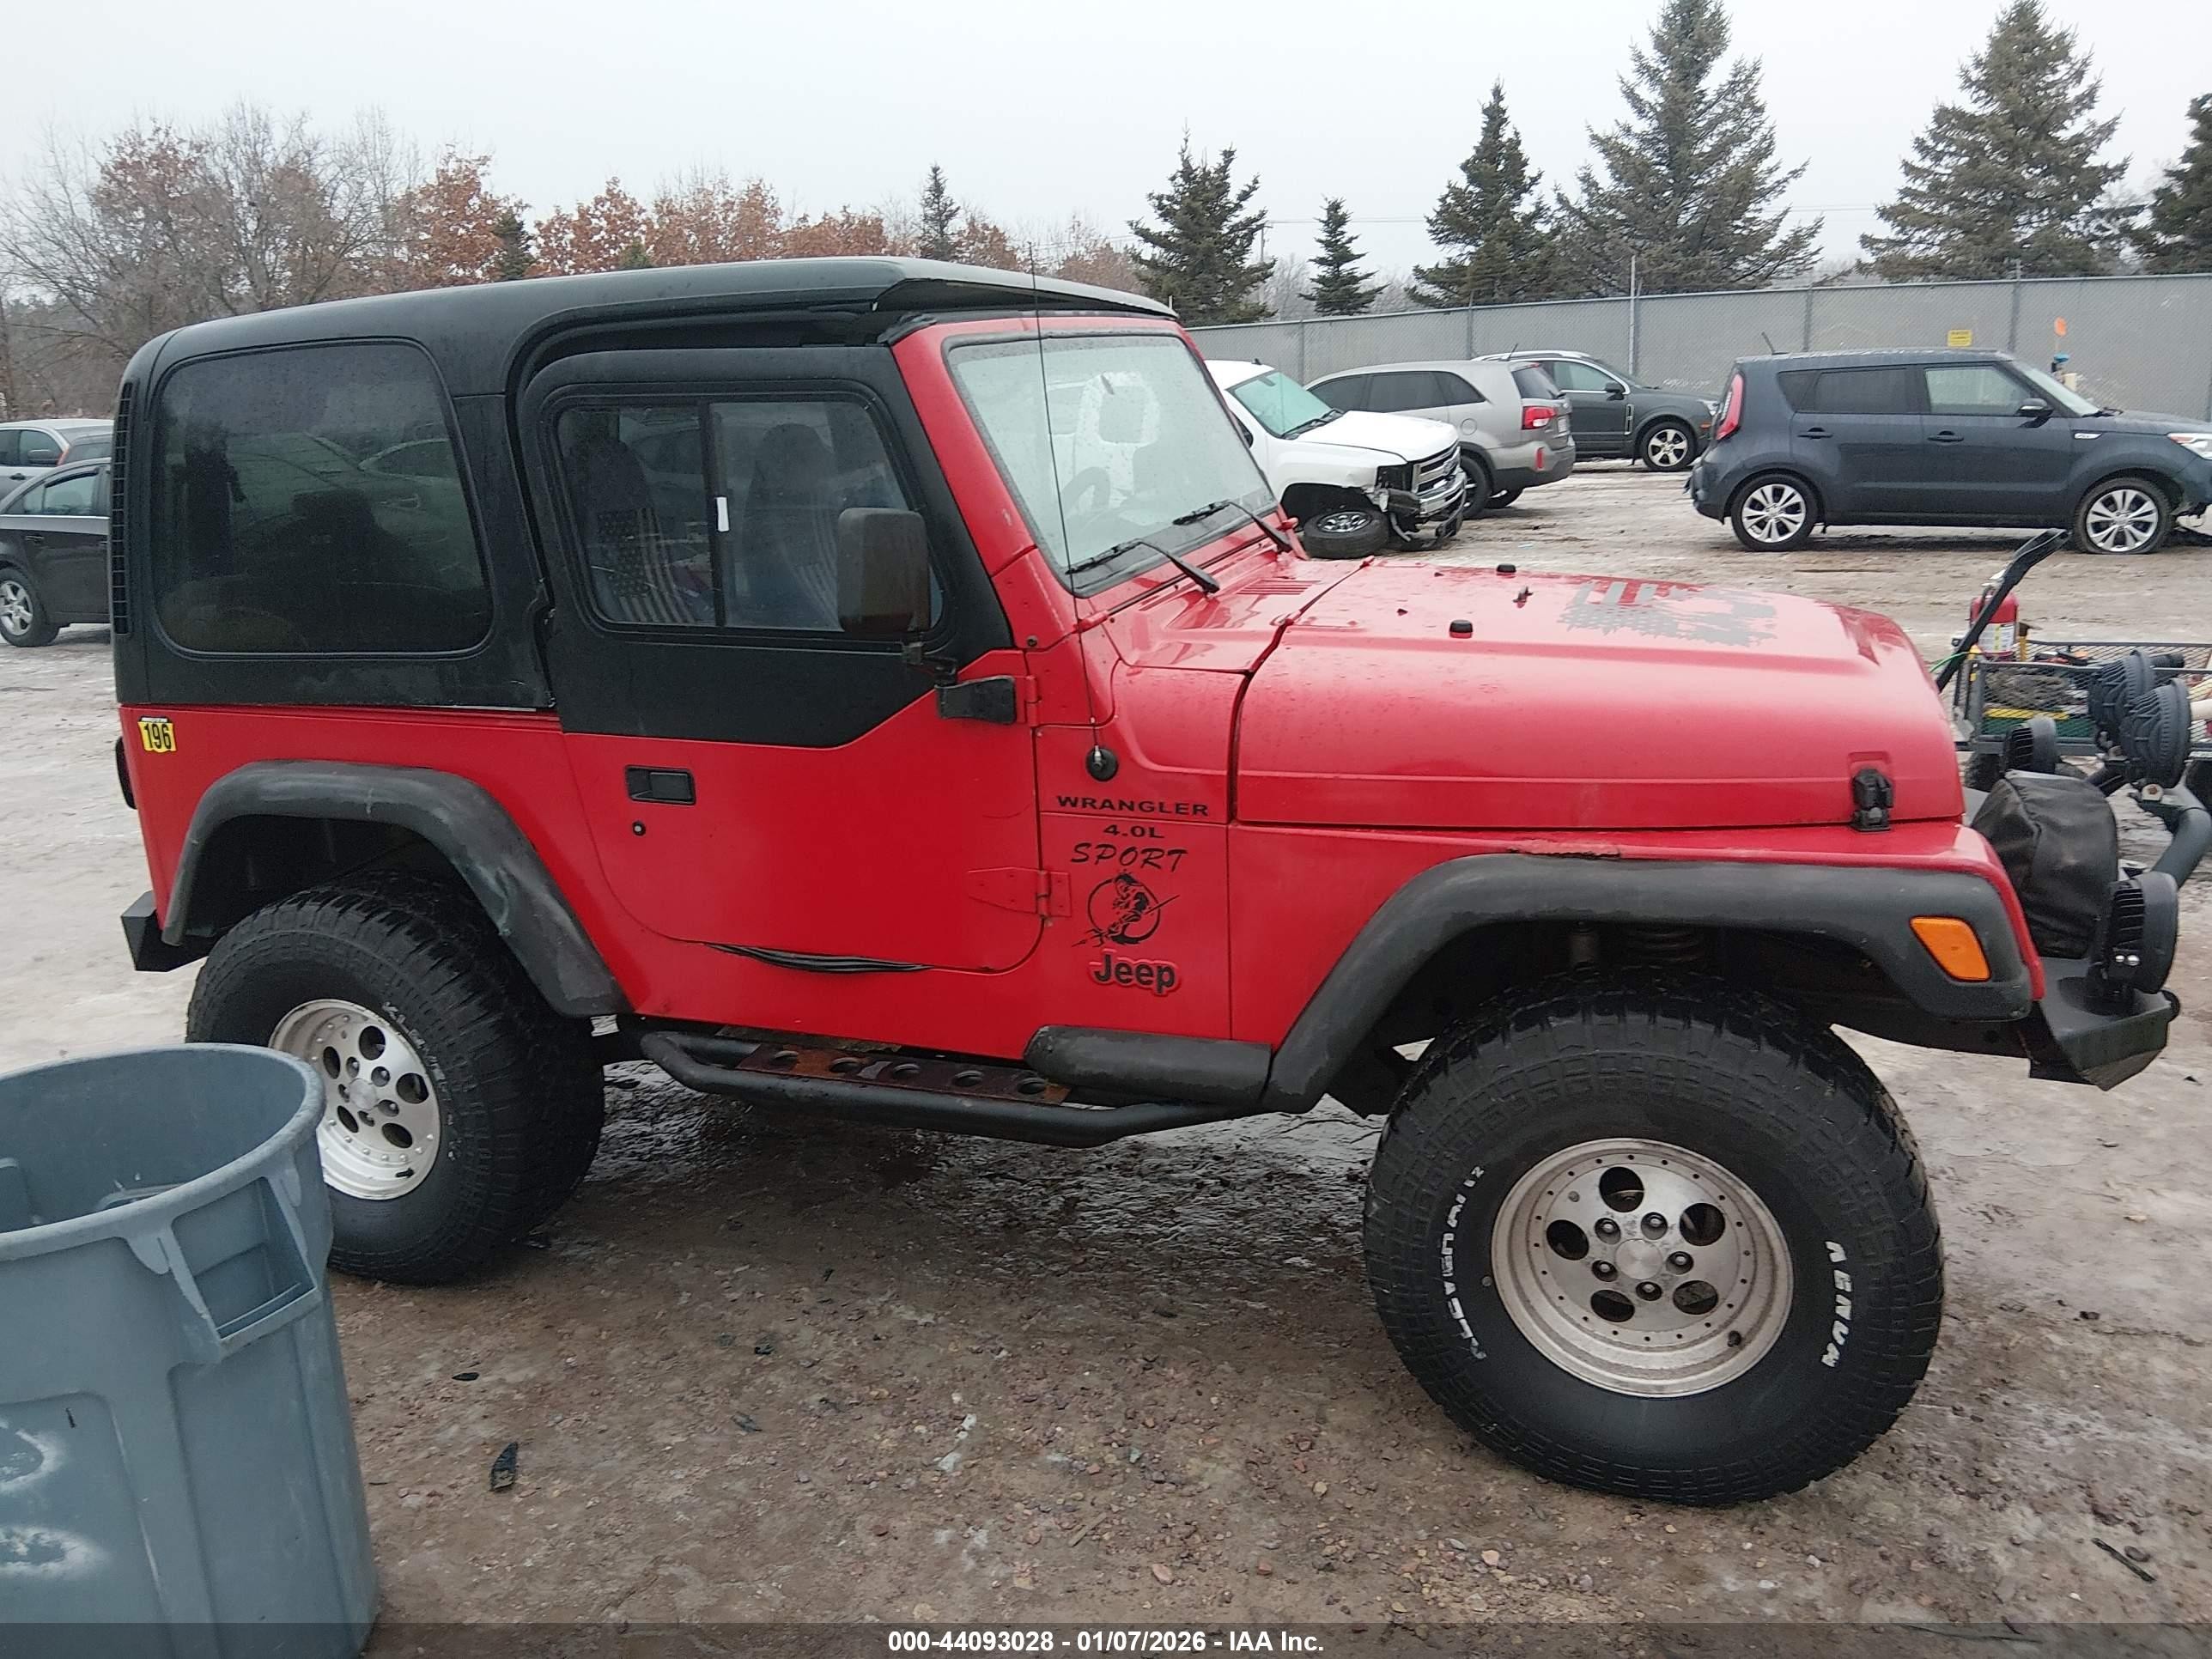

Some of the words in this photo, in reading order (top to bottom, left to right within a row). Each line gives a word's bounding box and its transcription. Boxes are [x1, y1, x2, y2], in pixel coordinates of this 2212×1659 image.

[143, 723, 172, 750] 196
[1056, 795, 1209, 817] WRANGLER
[1103, 823, 1165, 839] 4.0L
[1070, 842, 1188, 872] SPORT
[1093, 953, 1176, 994] Jeep
